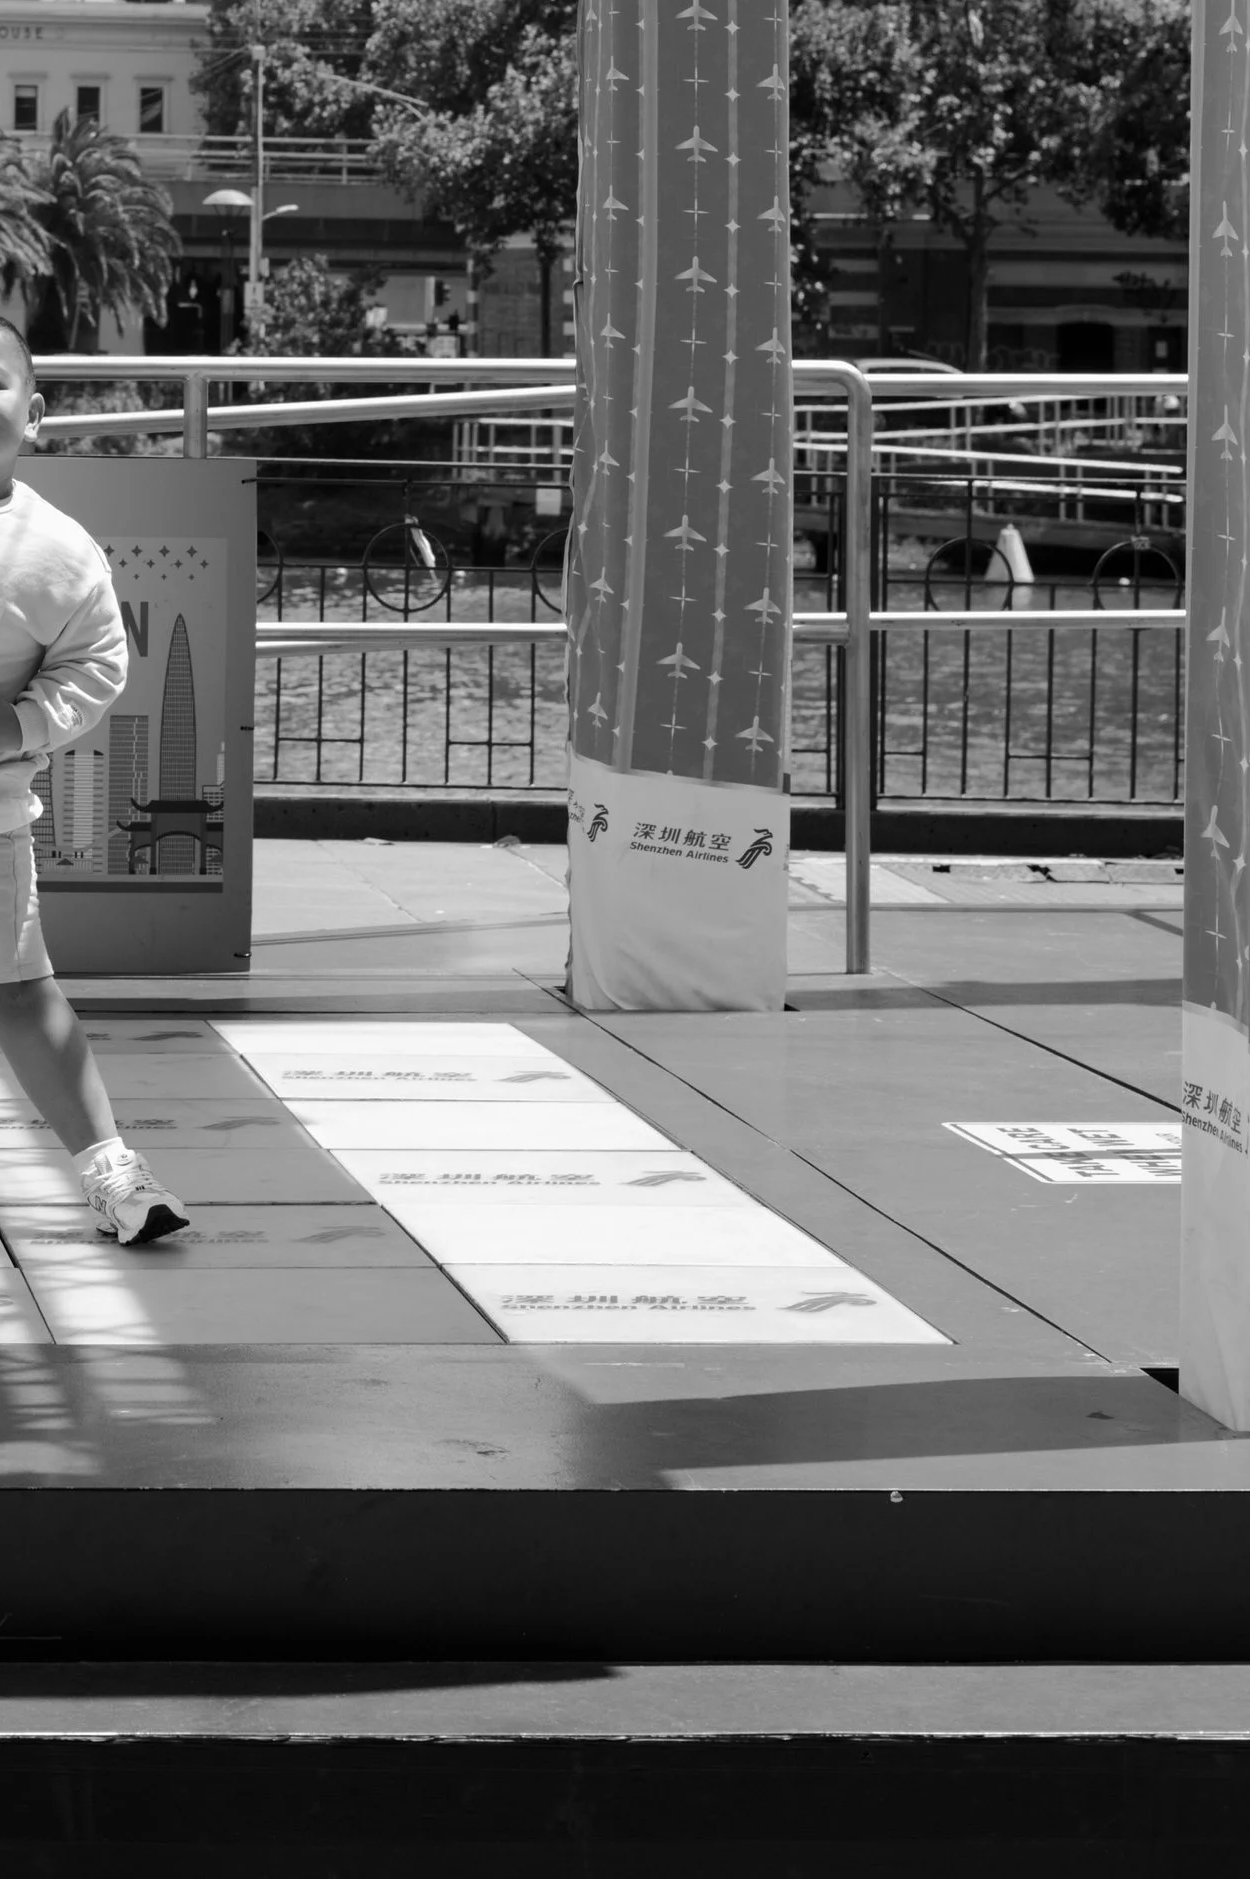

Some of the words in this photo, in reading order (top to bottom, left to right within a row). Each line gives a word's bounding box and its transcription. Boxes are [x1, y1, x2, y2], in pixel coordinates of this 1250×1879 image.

[632, 821, 733, 852] 深圳航空
[629, 840, 683, 857] Shenzhen
[685, 848, 730, 864] Airlines
[1182, 1080, 1242, 1135] 深圳航空
[995, 1127, 1071, 1151] CARE
[1066, 1127, 1136, 1147] WET
[501, 1294, 749, 1305] 深圳航空
